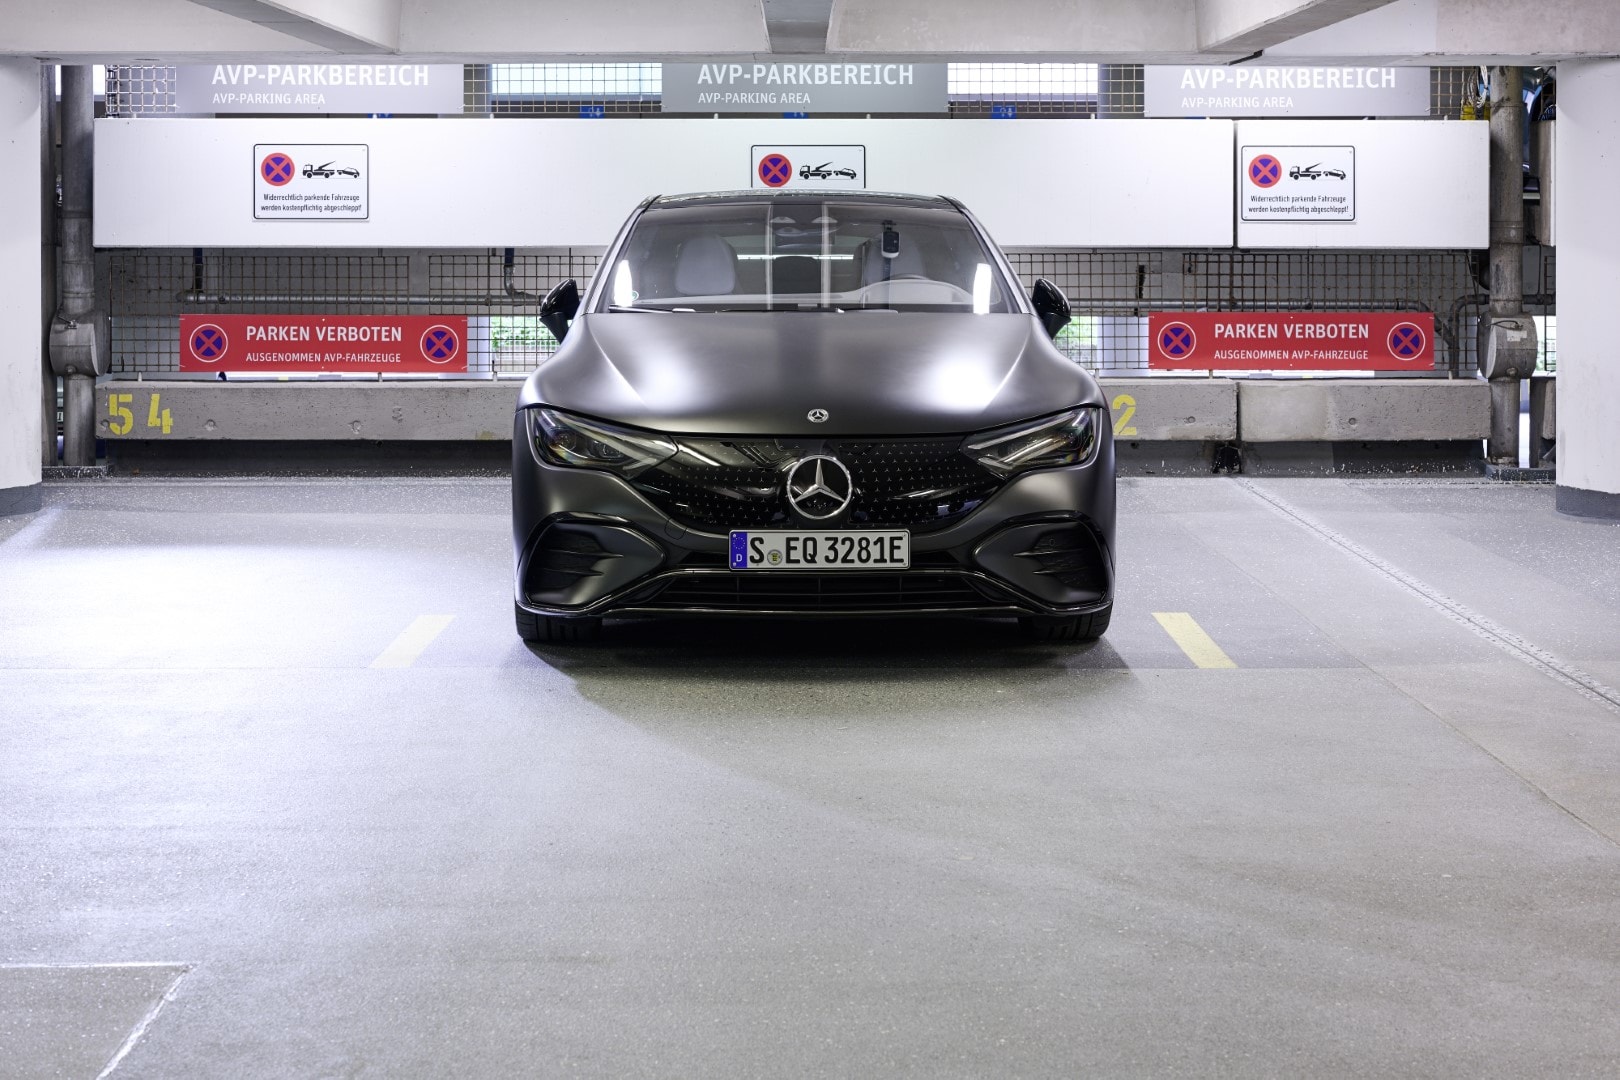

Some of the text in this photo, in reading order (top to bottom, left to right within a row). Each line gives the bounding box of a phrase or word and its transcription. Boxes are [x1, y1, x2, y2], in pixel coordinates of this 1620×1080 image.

[212, 64, 429, 86] AVP-PARKBEREICH
[697, 64, 913, 85] AVP-PARKBEREICH
[1181, 67, 1396, 89] AVP-PARKBEREICH
[213, 93, 325, 105] AVP-PARKING AREA
[698, 92, 811, 104] AVP-PARKING AREA
[1181, 97, 1294, 108] AVP-PARKING AREA
[263, 193, 360, 202] Widerrechtlich parkende Fahrzeuge
[1250, 195, 1346, 204] Widerrechtlich parkende Fahrzeuge
[282, 204, 323, 213] kostenpflichtig
[1270, 206, 1310, 214] kostenpflichtig
[1311, 206, 1349, 214] abgeschleppt!
[246, 326, 402, 342] PARKEN VERBOTEN
[1214, 323, 1369, 339] PARKEN VERBOTEN
[246, 352, 401, 363] AUSGENOMMEN AVP-FAHRZEUGE
[1214, 350, 1369, 360] AUSGENOMMEN AVP-FAHRZEUGE
[1112, 394, 1137, 436] 2
[749, 537, 765, 564] S
[735, 553, 743, 562] D
